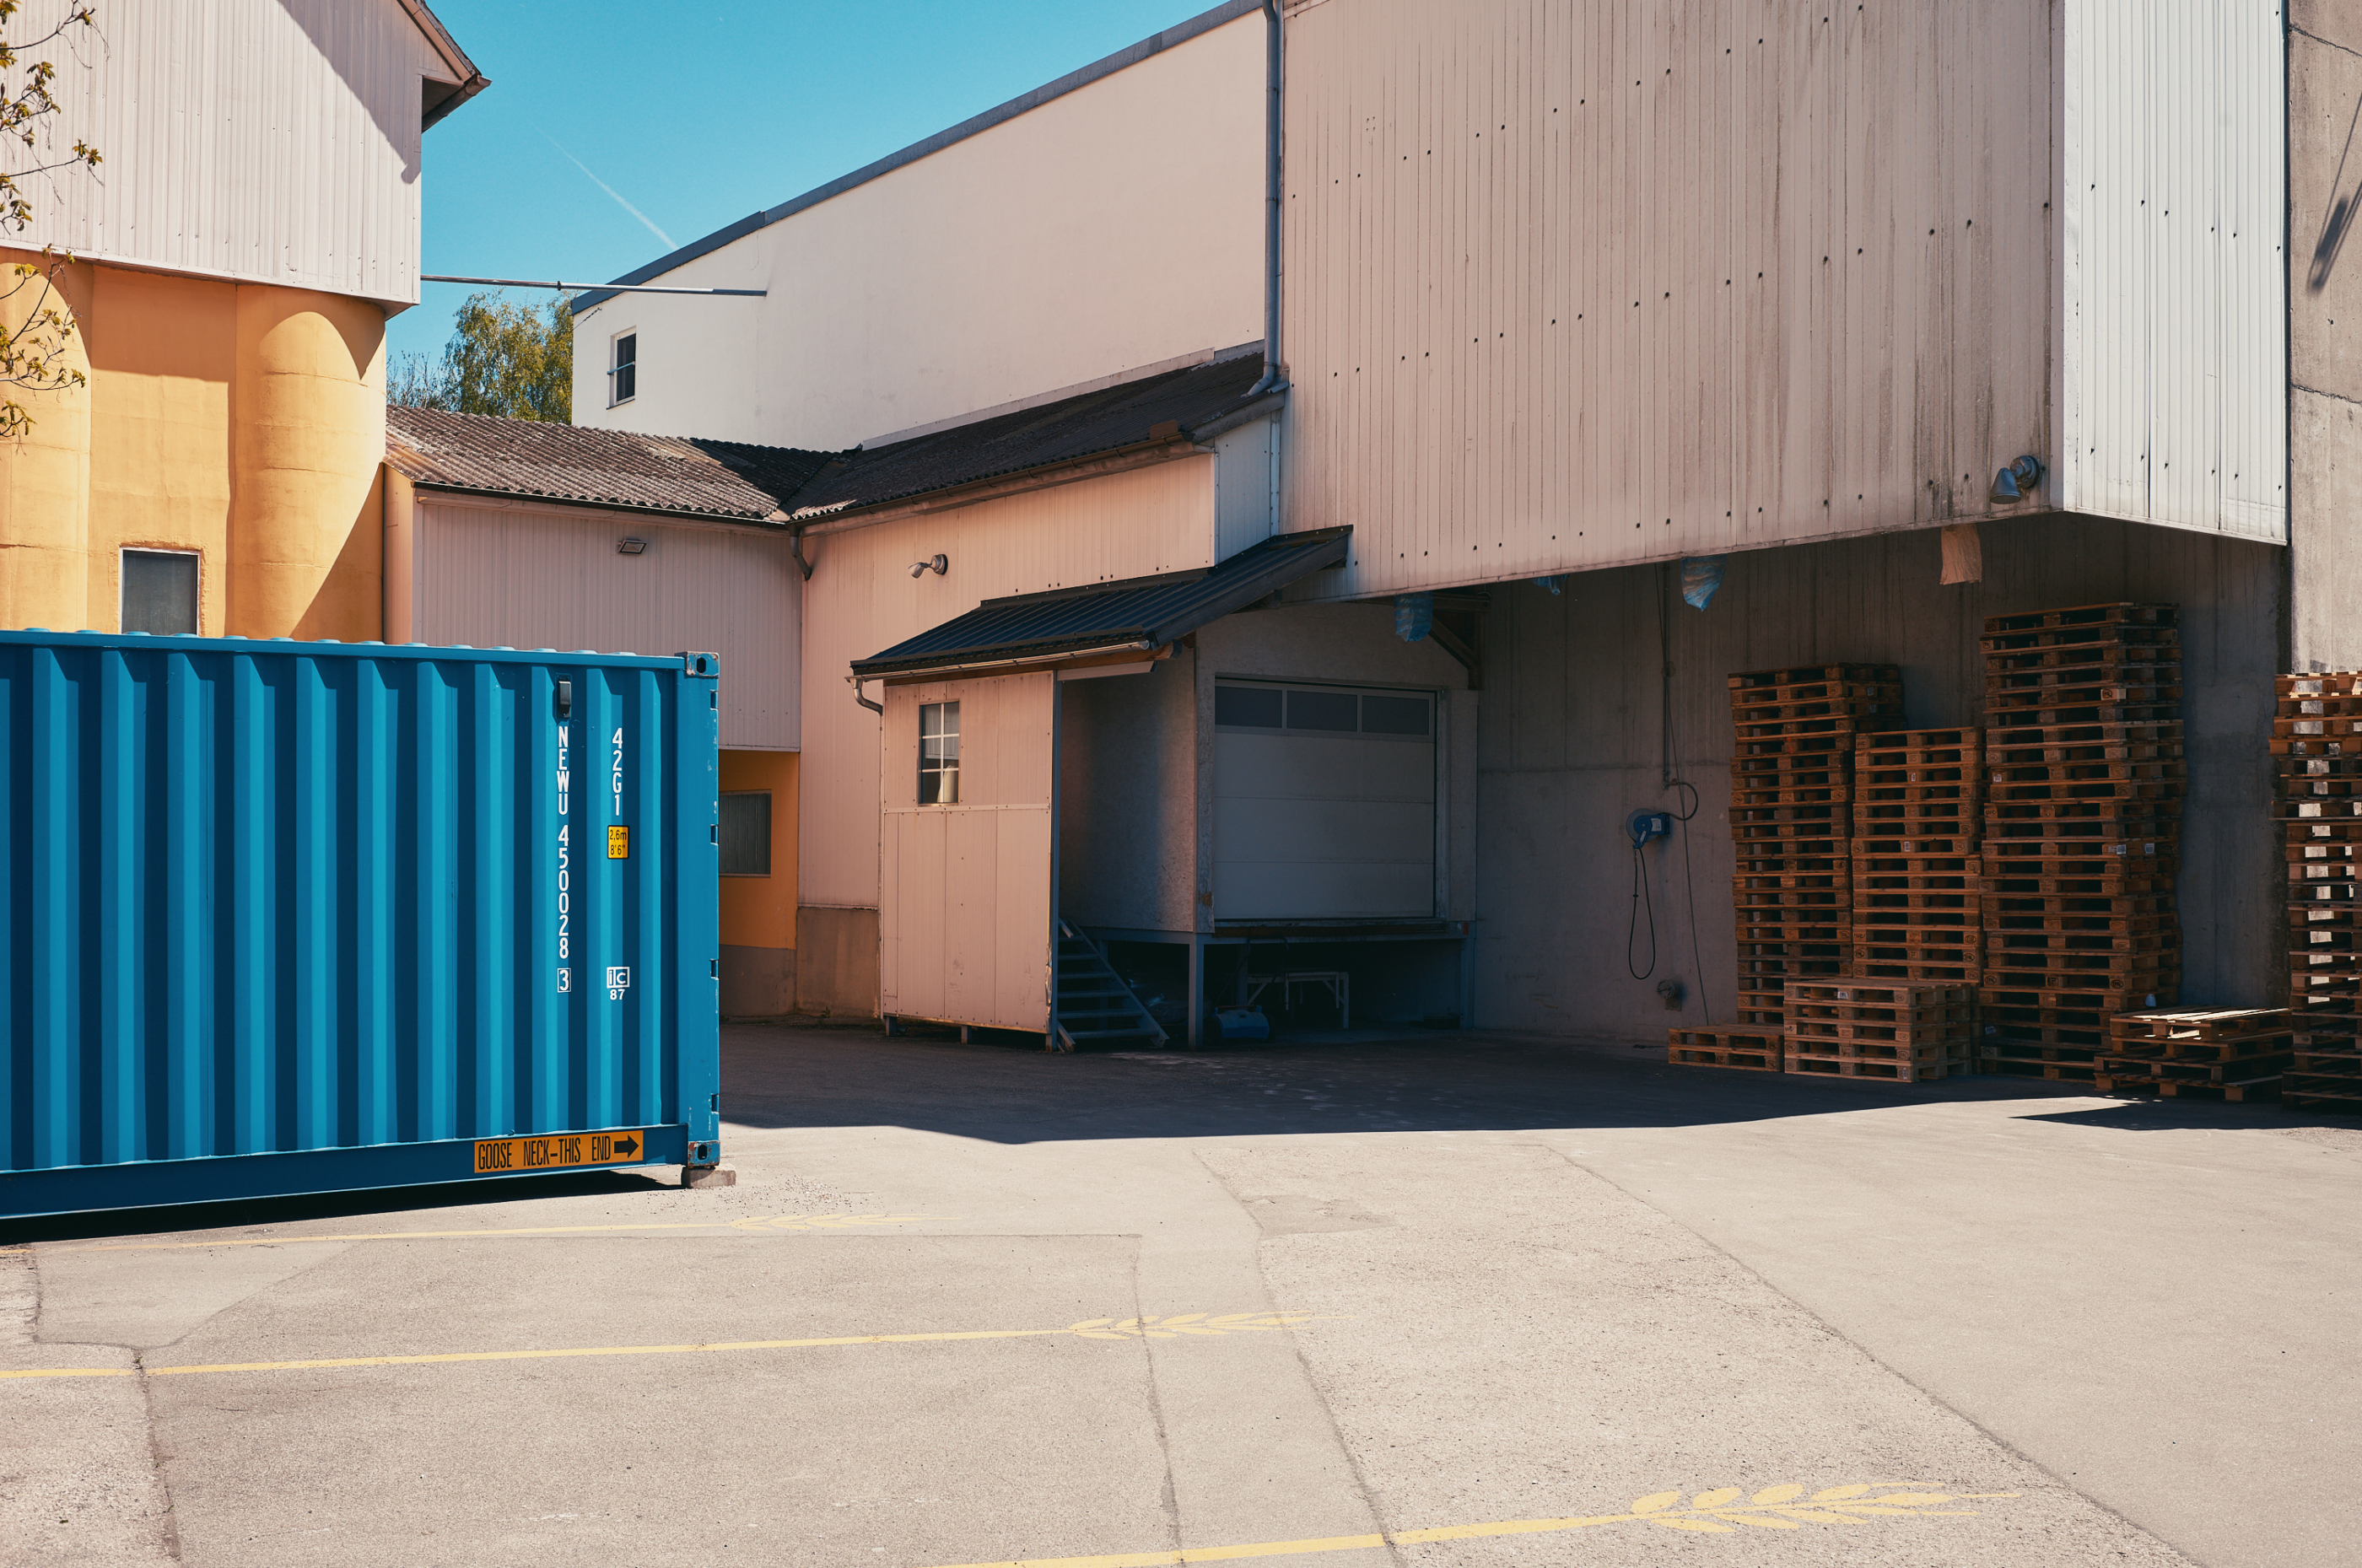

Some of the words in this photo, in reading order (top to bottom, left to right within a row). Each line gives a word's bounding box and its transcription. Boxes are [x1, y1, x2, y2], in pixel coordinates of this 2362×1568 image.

[557, 725, 570, 816] NEWU
[612, 727, 623, 816] 42G1
[609, 829, 627, 842] 2,6m
[558, 824, 569, 960] 450028
[559, 969, 569, 992] 3
[609, 989, 626, 1000] 87
[478, 1142, 512, 1170] GOOSE
[591, 1135, 611, 1161] END
